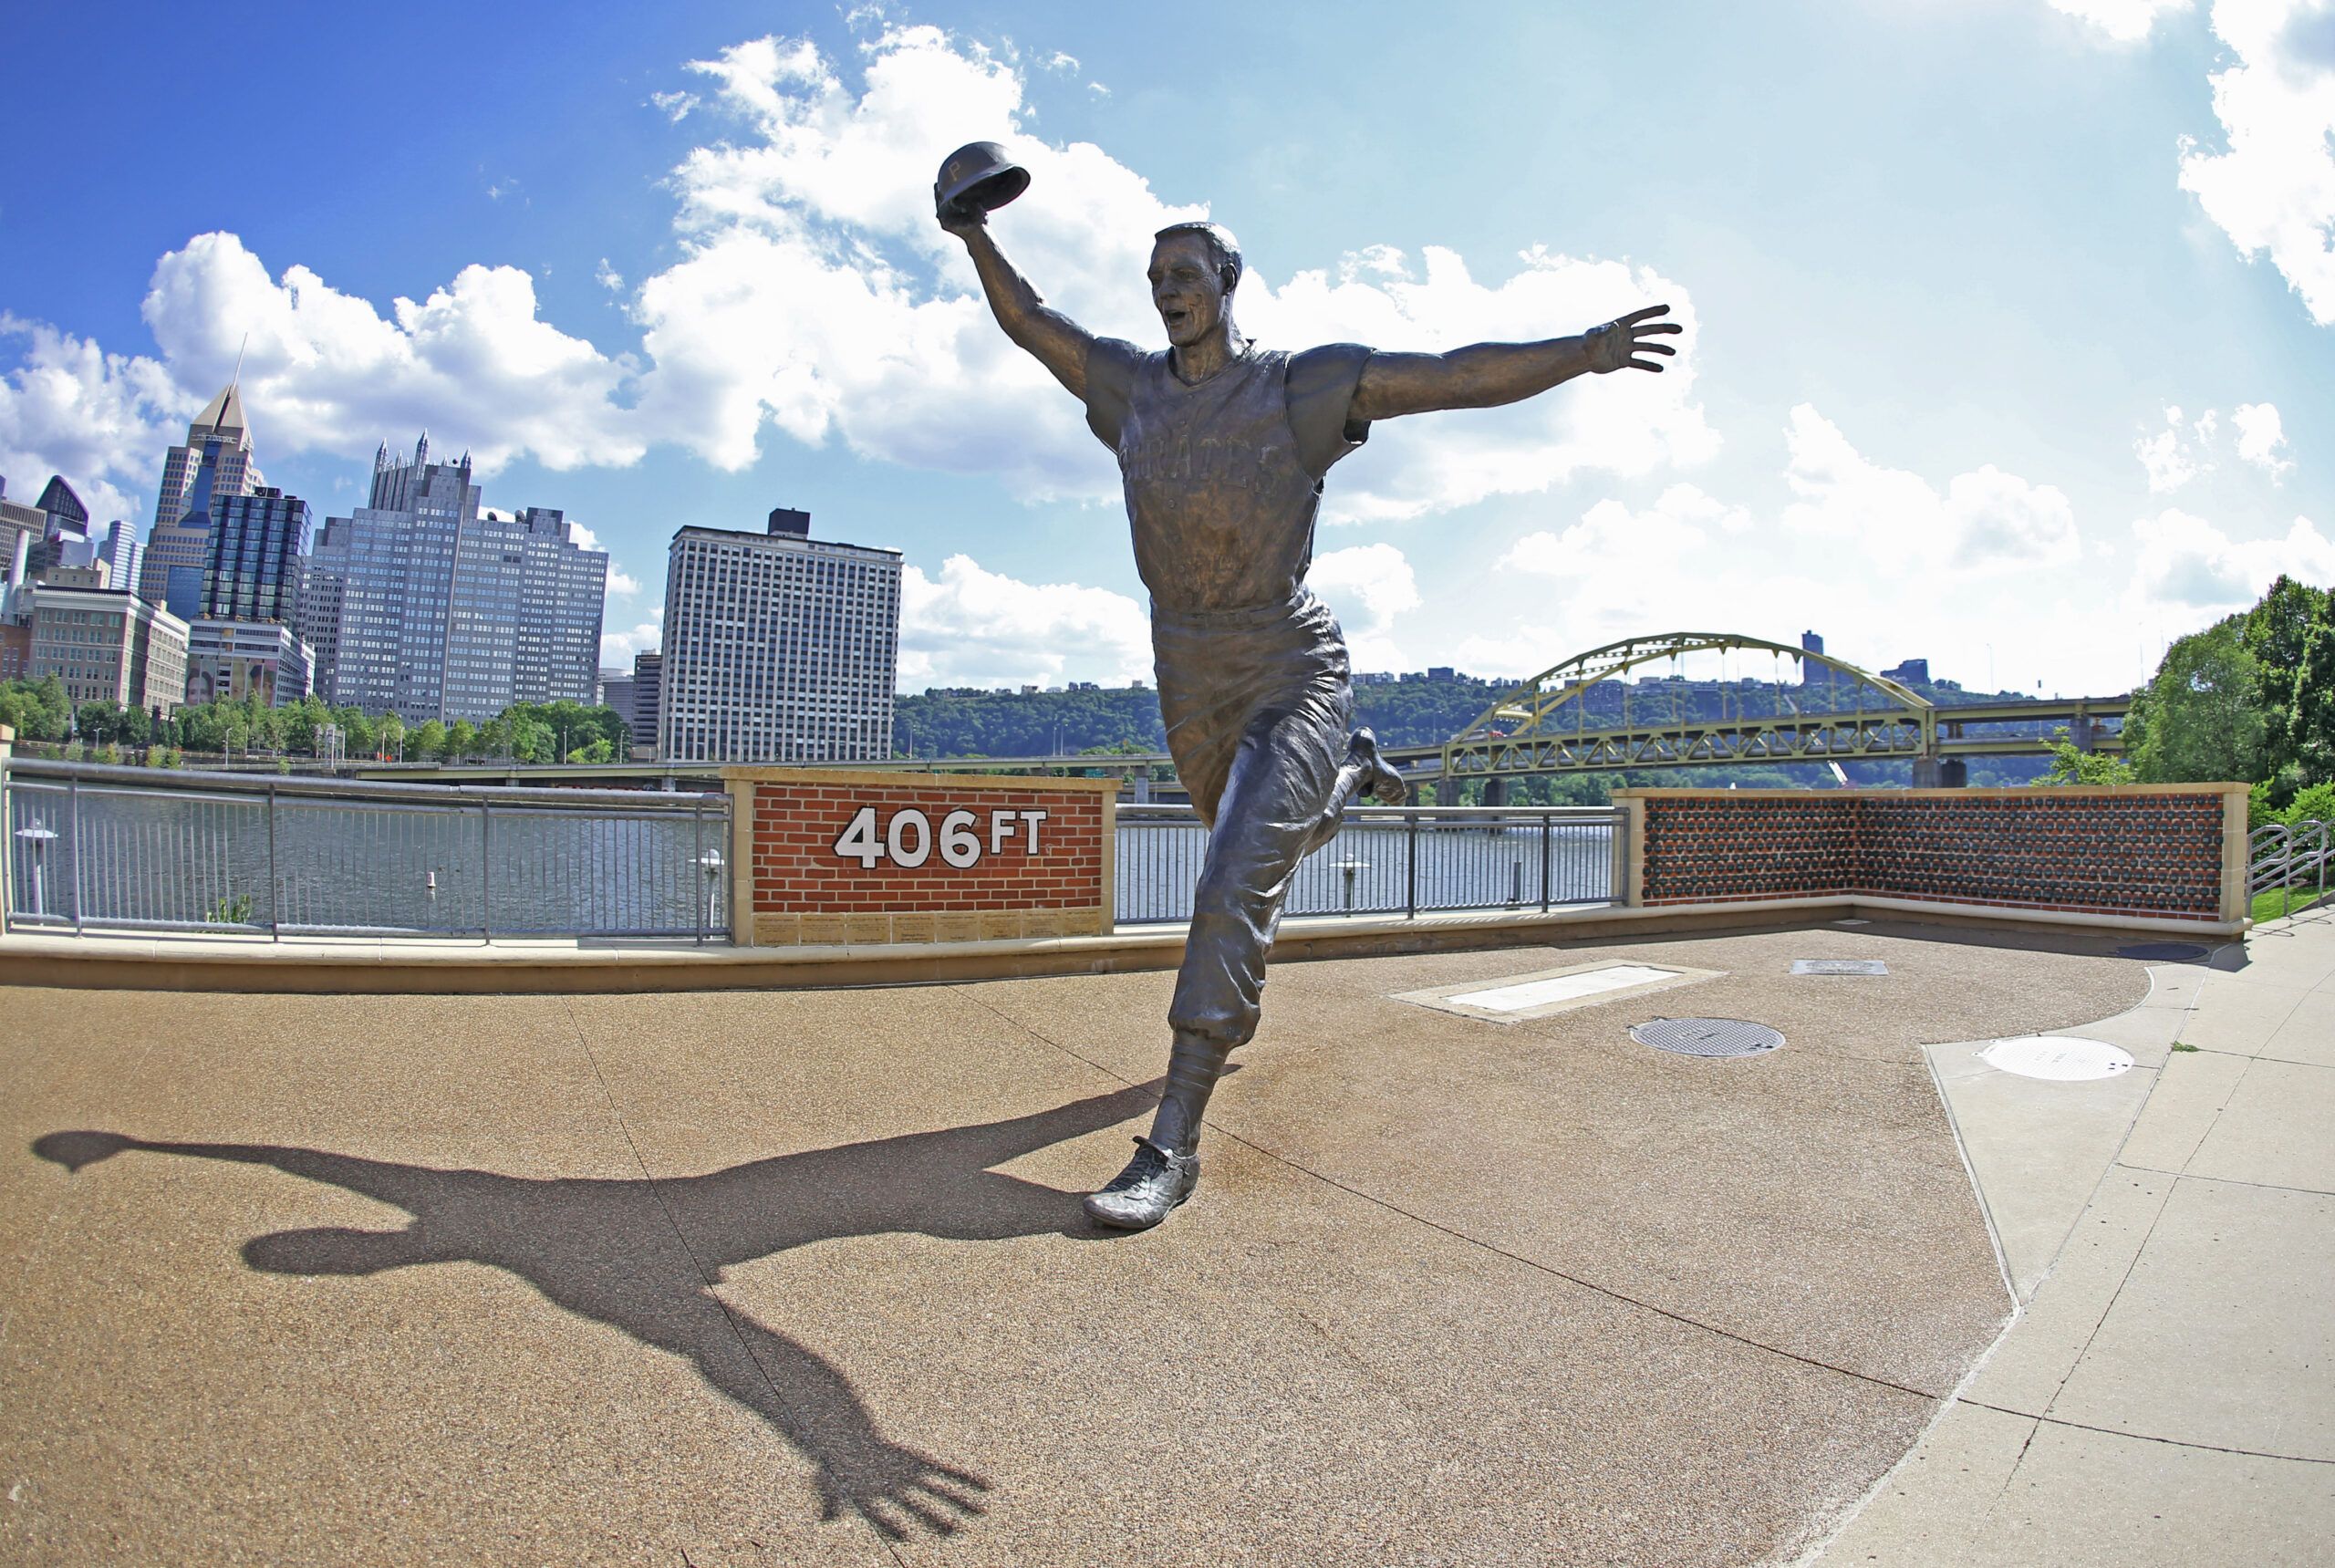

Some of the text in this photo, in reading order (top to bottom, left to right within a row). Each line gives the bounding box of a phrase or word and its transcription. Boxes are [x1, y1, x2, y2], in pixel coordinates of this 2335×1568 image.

[949, 161, 960, 182] P
[832, 806, 1048, 868] 406 FT
